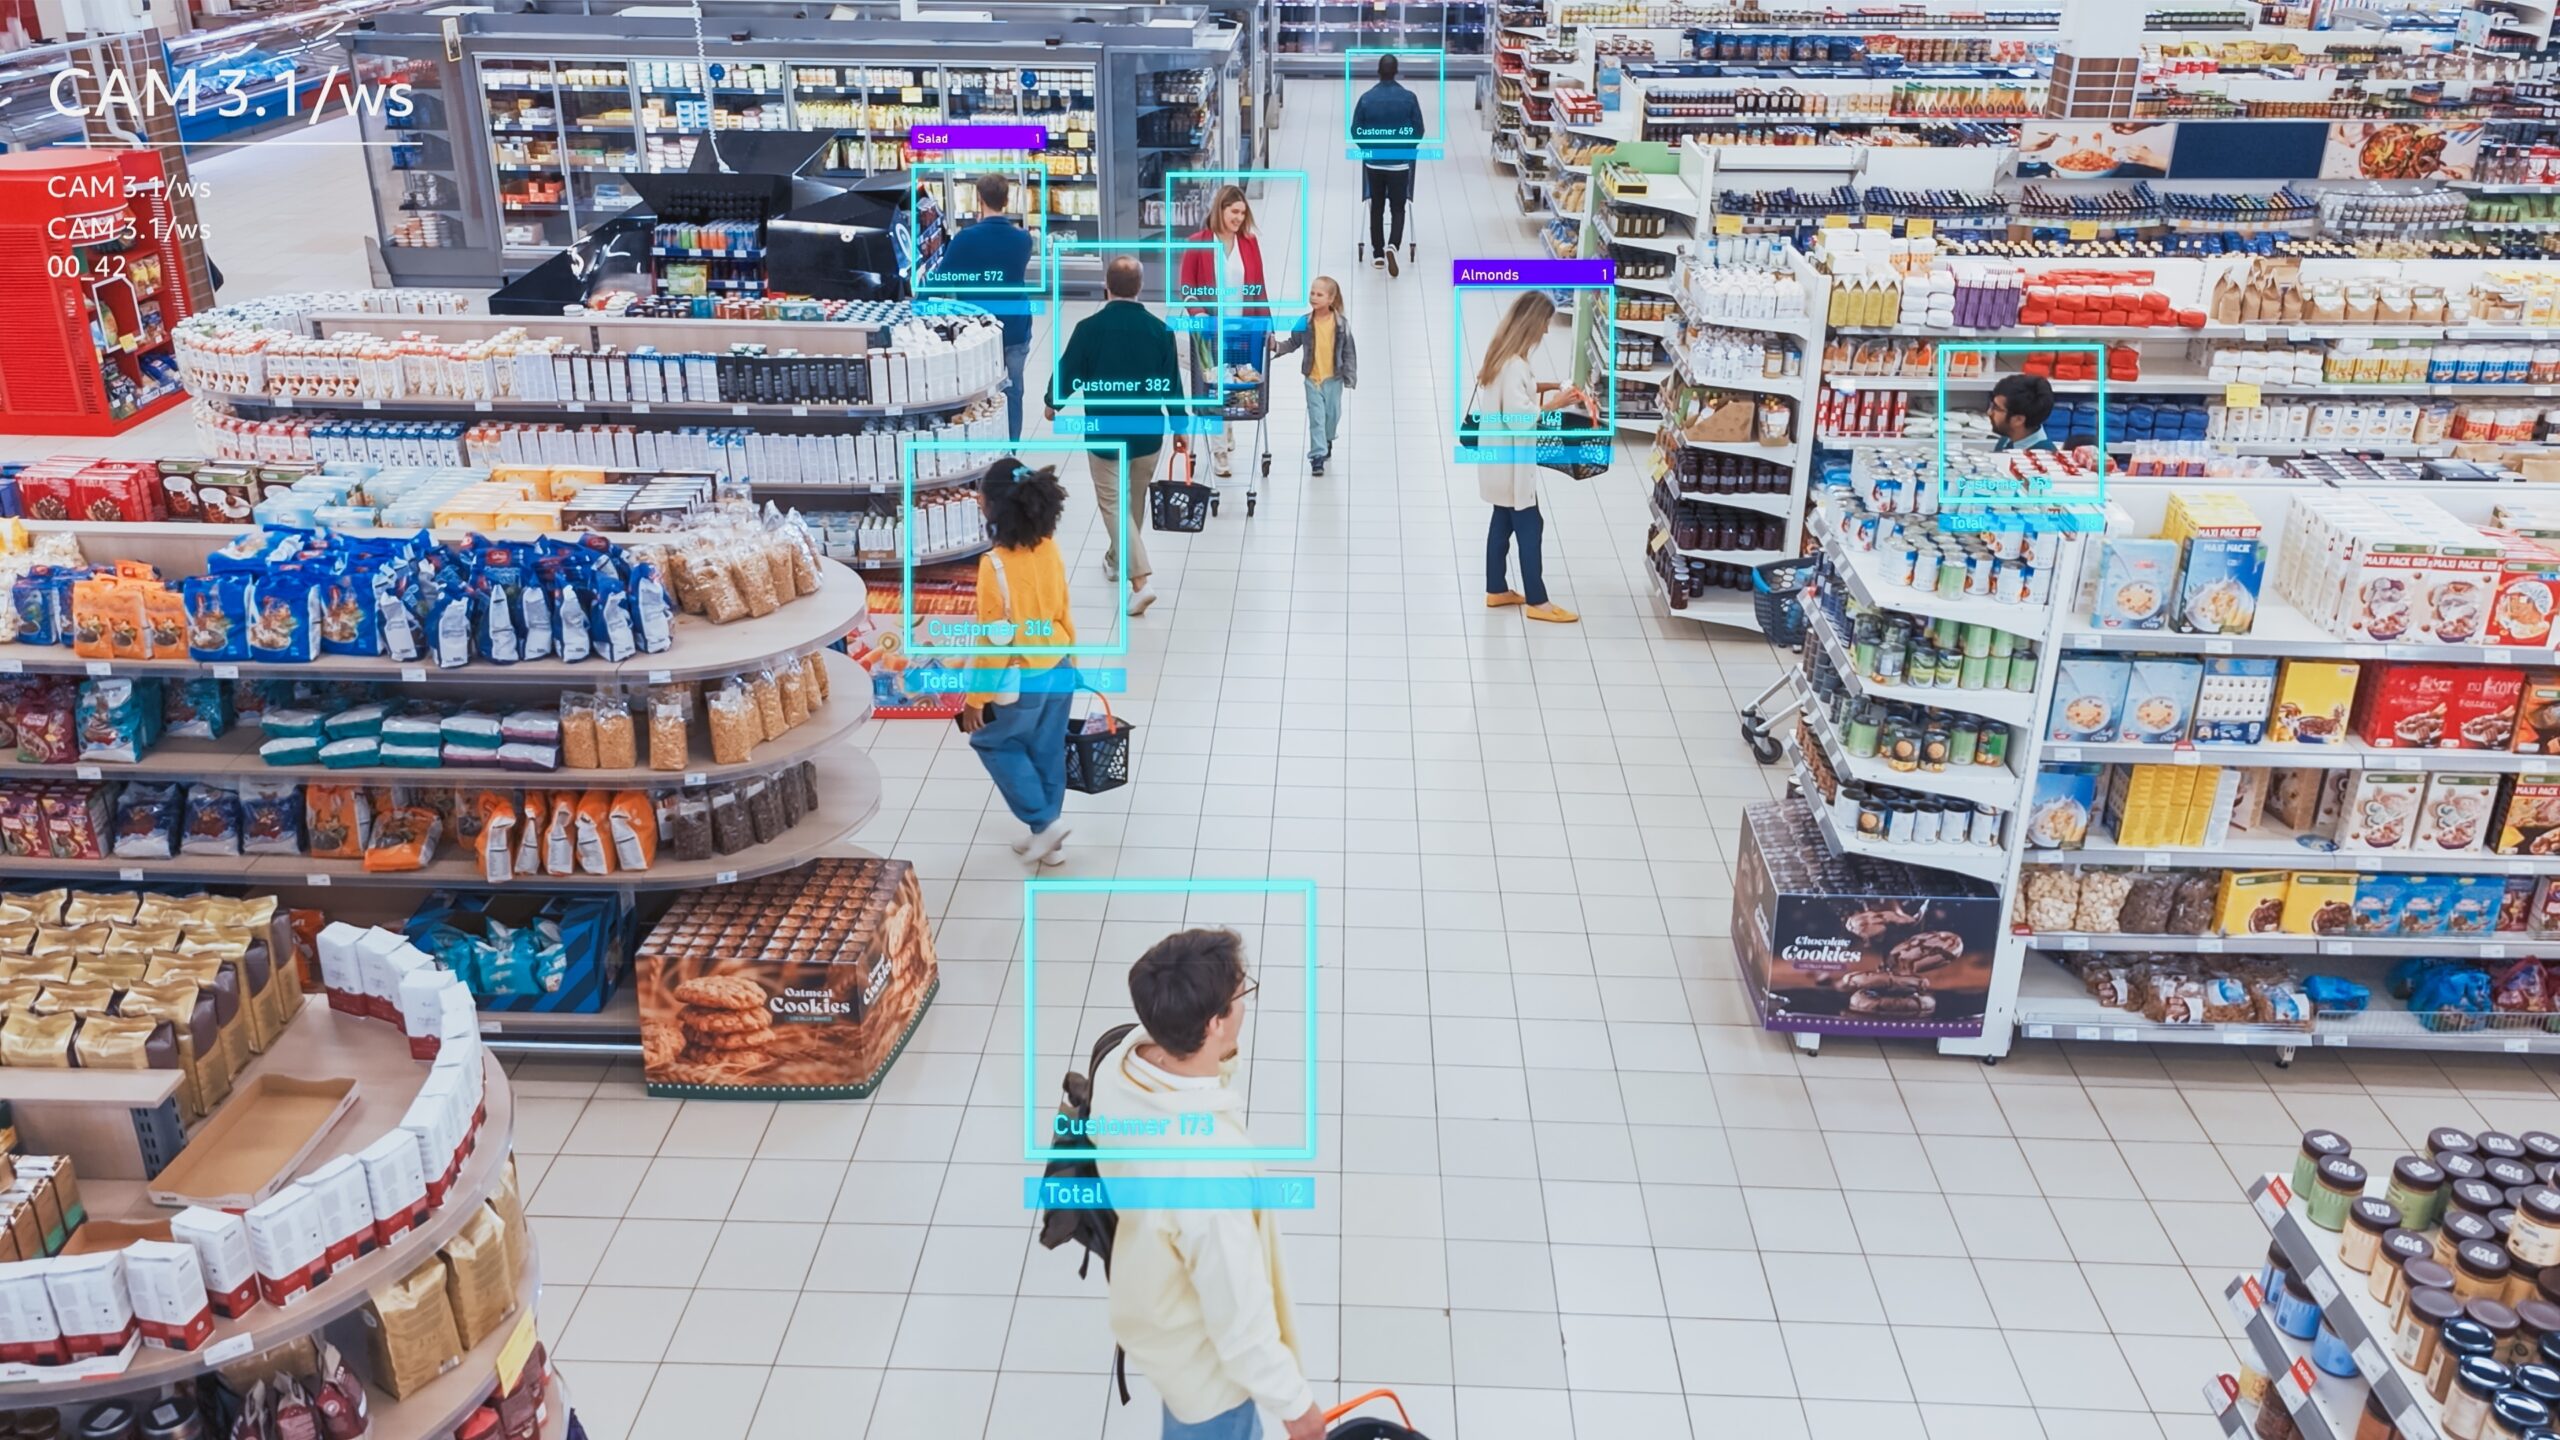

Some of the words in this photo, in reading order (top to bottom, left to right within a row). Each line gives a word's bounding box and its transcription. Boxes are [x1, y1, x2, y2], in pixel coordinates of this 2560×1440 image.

[1794, 935, 1852, 947] Chocolate
[1781, 945, 1862, 963] Cookies
[783, 987, 833, 998] Oatmeal
[769, 996, 851, 1014] Cookies
